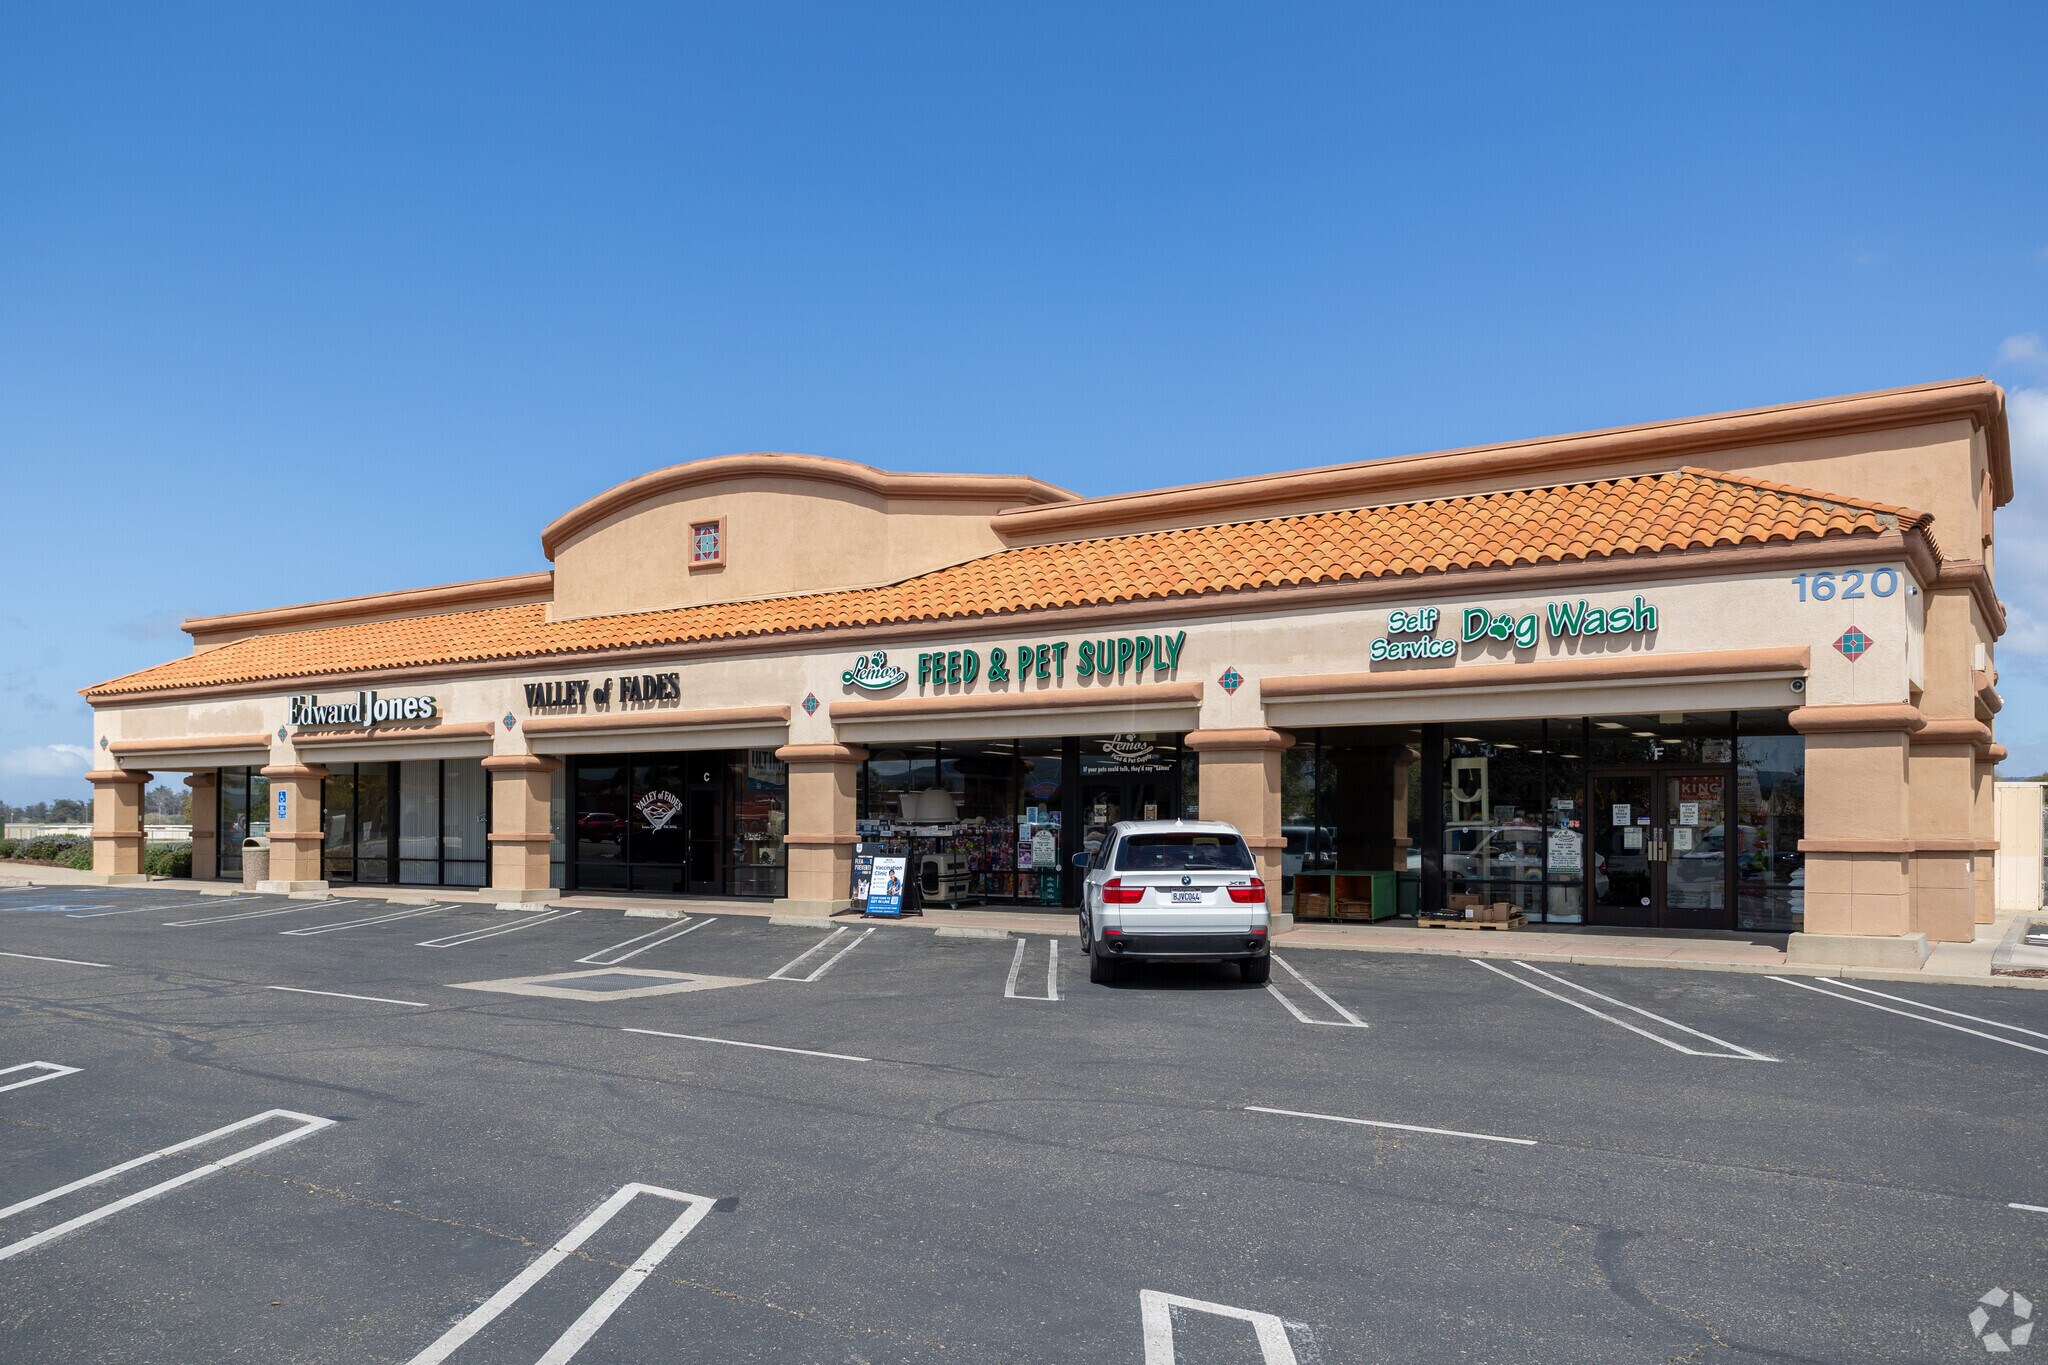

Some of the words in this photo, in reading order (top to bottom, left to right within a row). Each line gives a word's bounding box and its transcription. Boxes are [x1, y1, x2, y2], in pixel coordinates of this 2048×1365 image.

[1791, 567, 1898, 602] 1620
[1387, 607, 1439, 634] Self
[1546, 595, 1659, 637] Wash
[918, 649, 979, 686] FEED
[988, 647, 1009, 682] &
[1018, 641, 1069, 681] PET
[1076, 630, 1187, 676] SUPPLY
[1369, 636, 1457, 661] Service
[842, 655, 905, 689] Lemos
[523, 679, 590, 708] VALLEY
[593, 678, 613, 705] of
[619, 672, 681, 703] FADES
[286, 691, 363, 726] Edward
[363, 691, 437, 727] Jones
[1102, 734, 1154, 758] Lemos
[1654, 747, 1664, 760] F
[752, 750, 785, 770] ULTIM
[703, 772, 710, 782] C
[1682, 783, 1719, 793] KING
